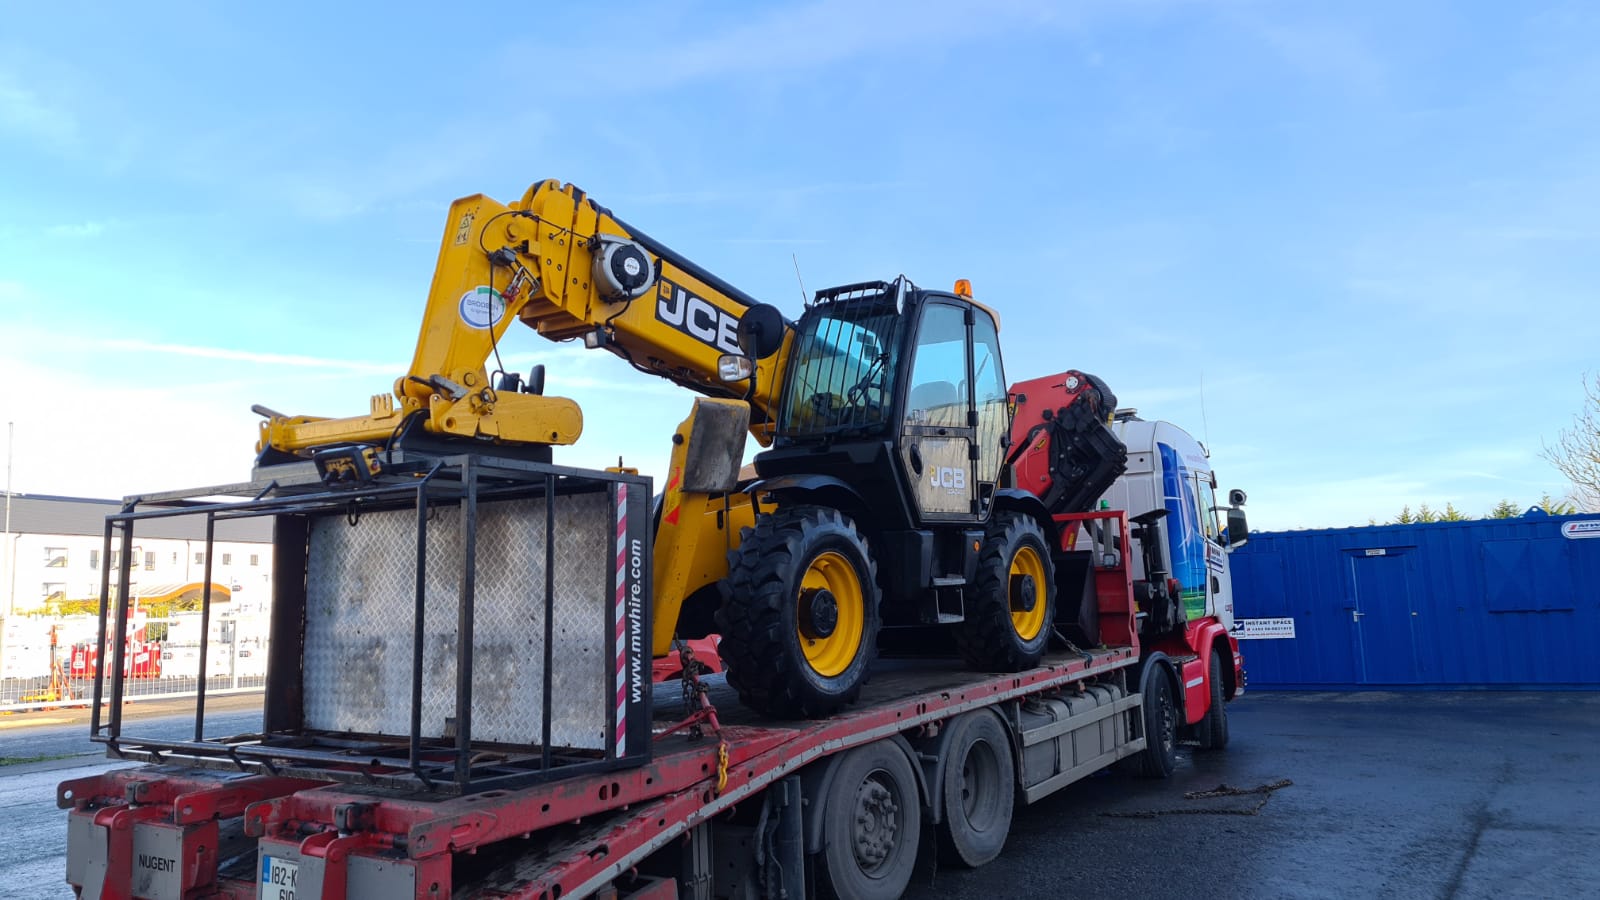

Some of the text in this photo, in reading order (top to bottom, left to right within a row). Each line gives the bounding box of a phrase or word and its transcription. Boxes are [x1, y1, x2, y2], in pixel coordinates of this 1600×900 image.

[931, 466, 965, 488] JCB
[628, 539, 641, 703] www.mwhire.com
[138, 854, 175, 872] NUGENT
